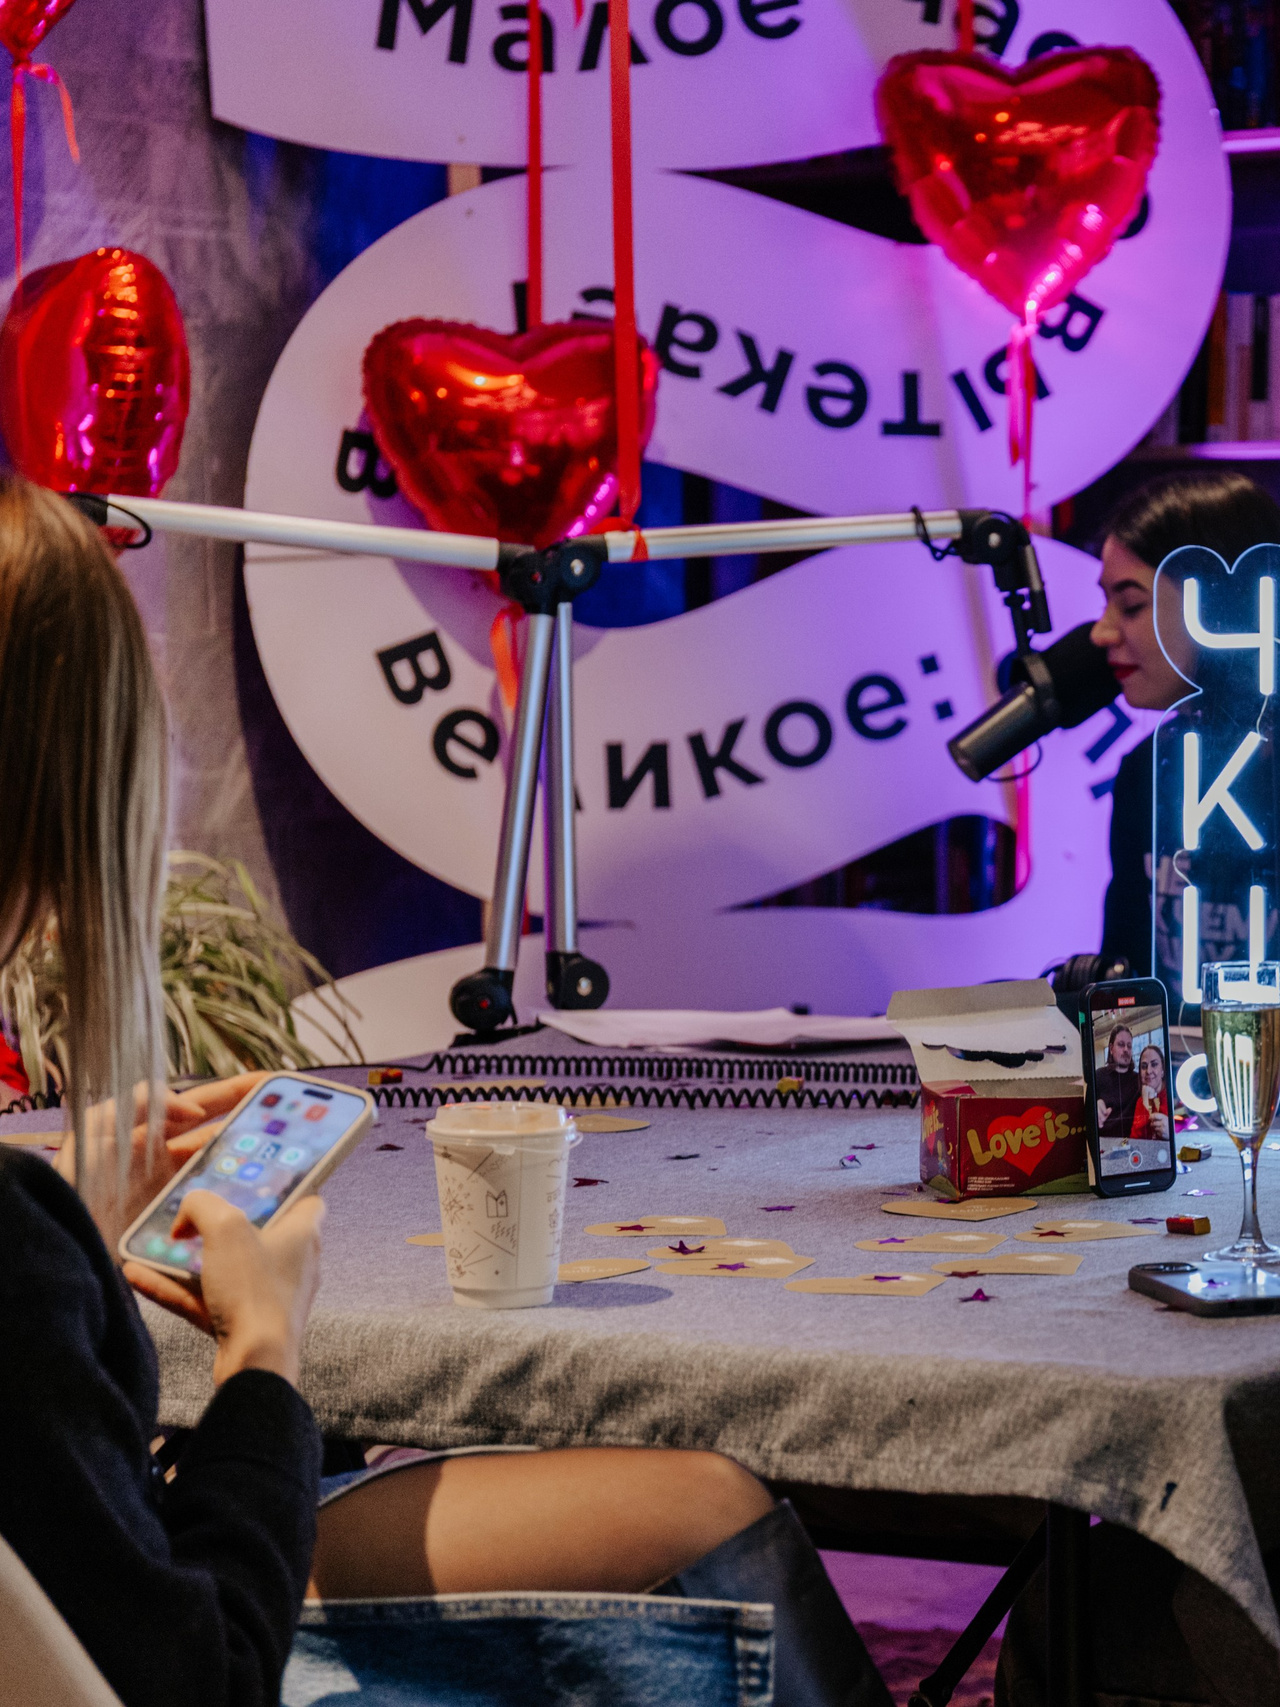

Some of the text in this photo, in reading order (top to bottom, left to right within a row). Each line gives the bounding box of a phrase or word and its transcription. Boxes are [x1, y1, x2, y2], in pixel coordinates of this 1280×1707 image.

[376, 629, 956, 811] Веикое:
[1183, 731, 1268, 850] К
[966, 1124, 1042, 1166] Love
